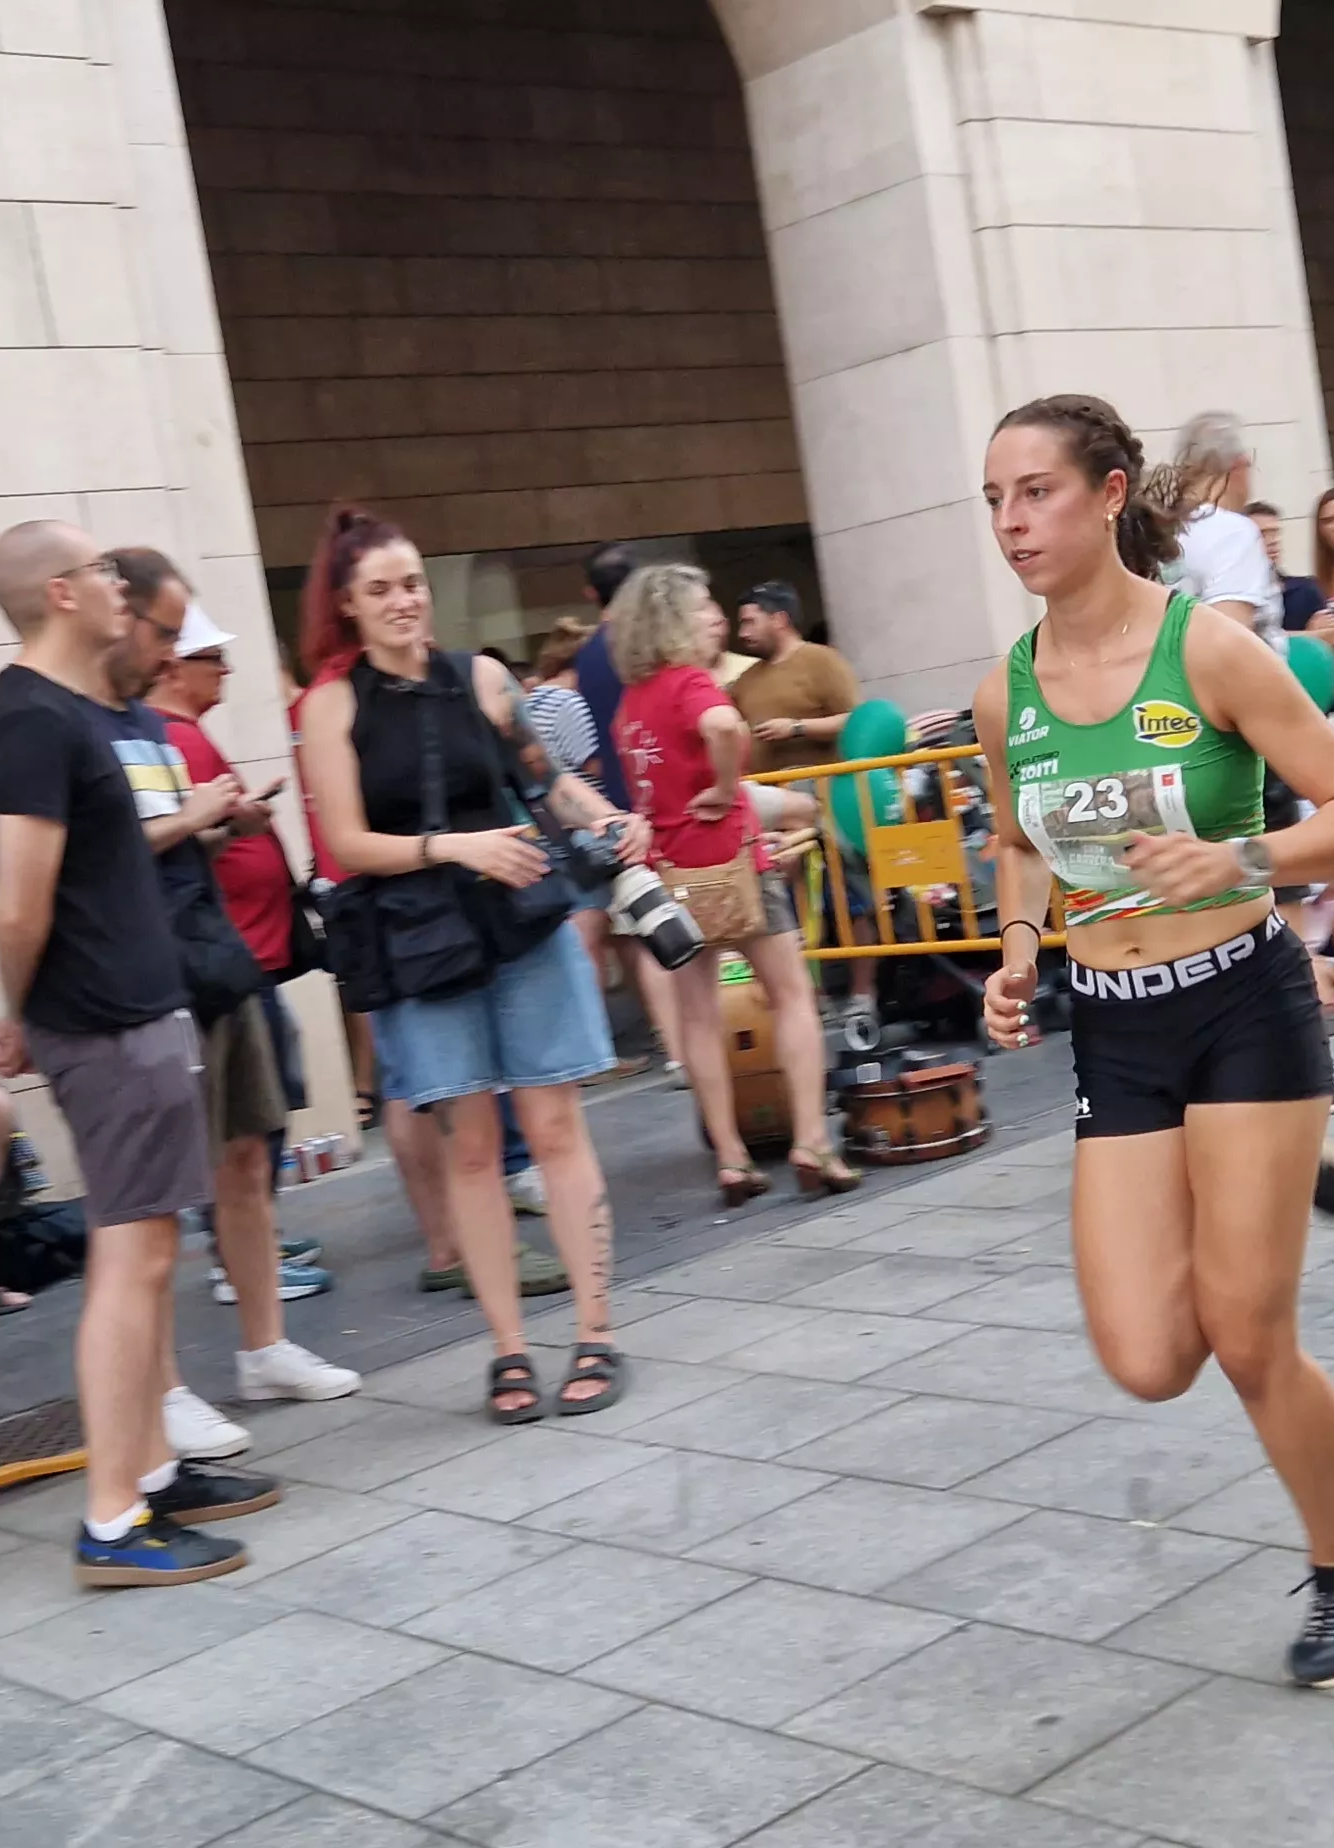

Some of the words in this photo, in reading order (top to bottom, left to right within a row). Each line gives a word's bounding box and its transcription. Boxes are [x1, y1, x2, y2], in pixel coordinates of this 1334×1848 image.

[1008, 725, 1050, 747] VIATOR
[1063, 778, 1129, 823] 23
[1070, 933, 1256, 1000] UNDER
